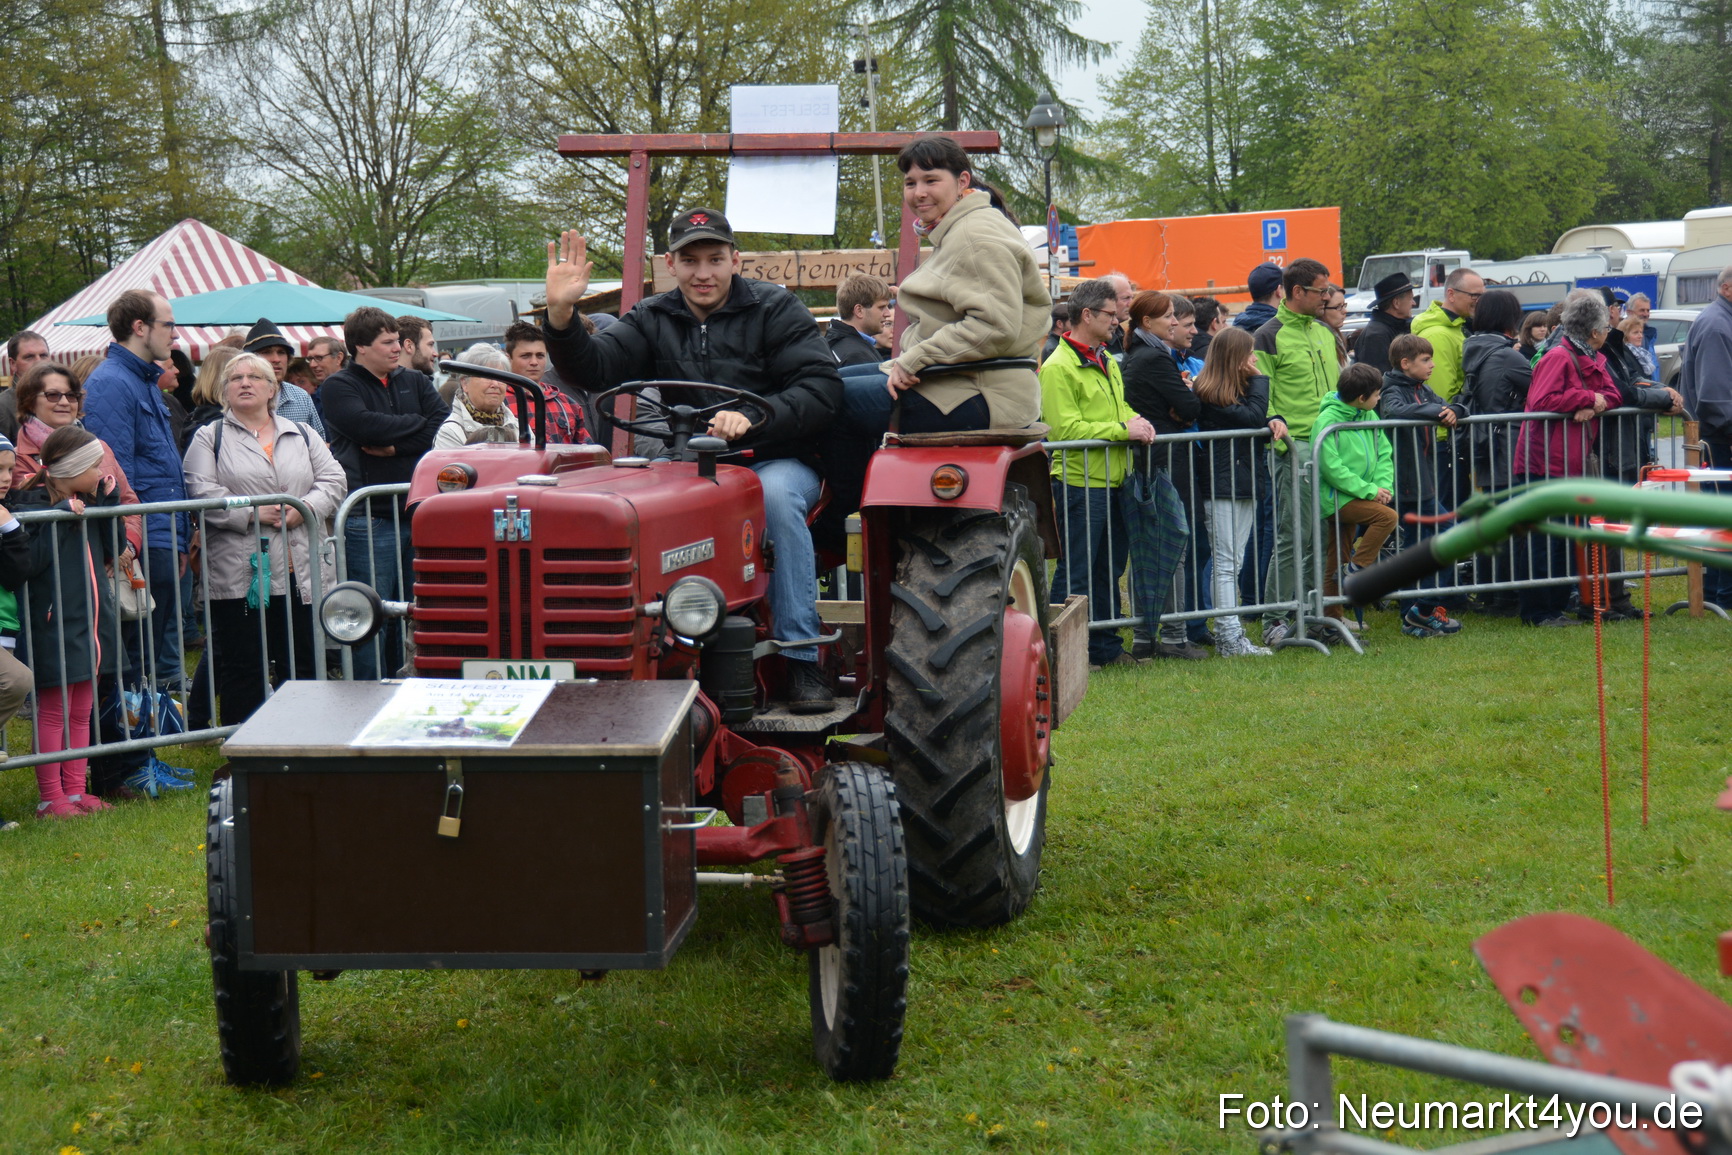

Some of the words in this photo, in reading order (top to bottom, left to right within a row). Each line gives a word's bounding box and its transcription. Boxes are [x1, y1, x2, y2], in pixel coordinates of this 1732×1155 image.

[1267, 223, 1281, 247] P
[740, 255, 892, 281] Eselrennsta
[413, 682, 512, 691] SELFEST
